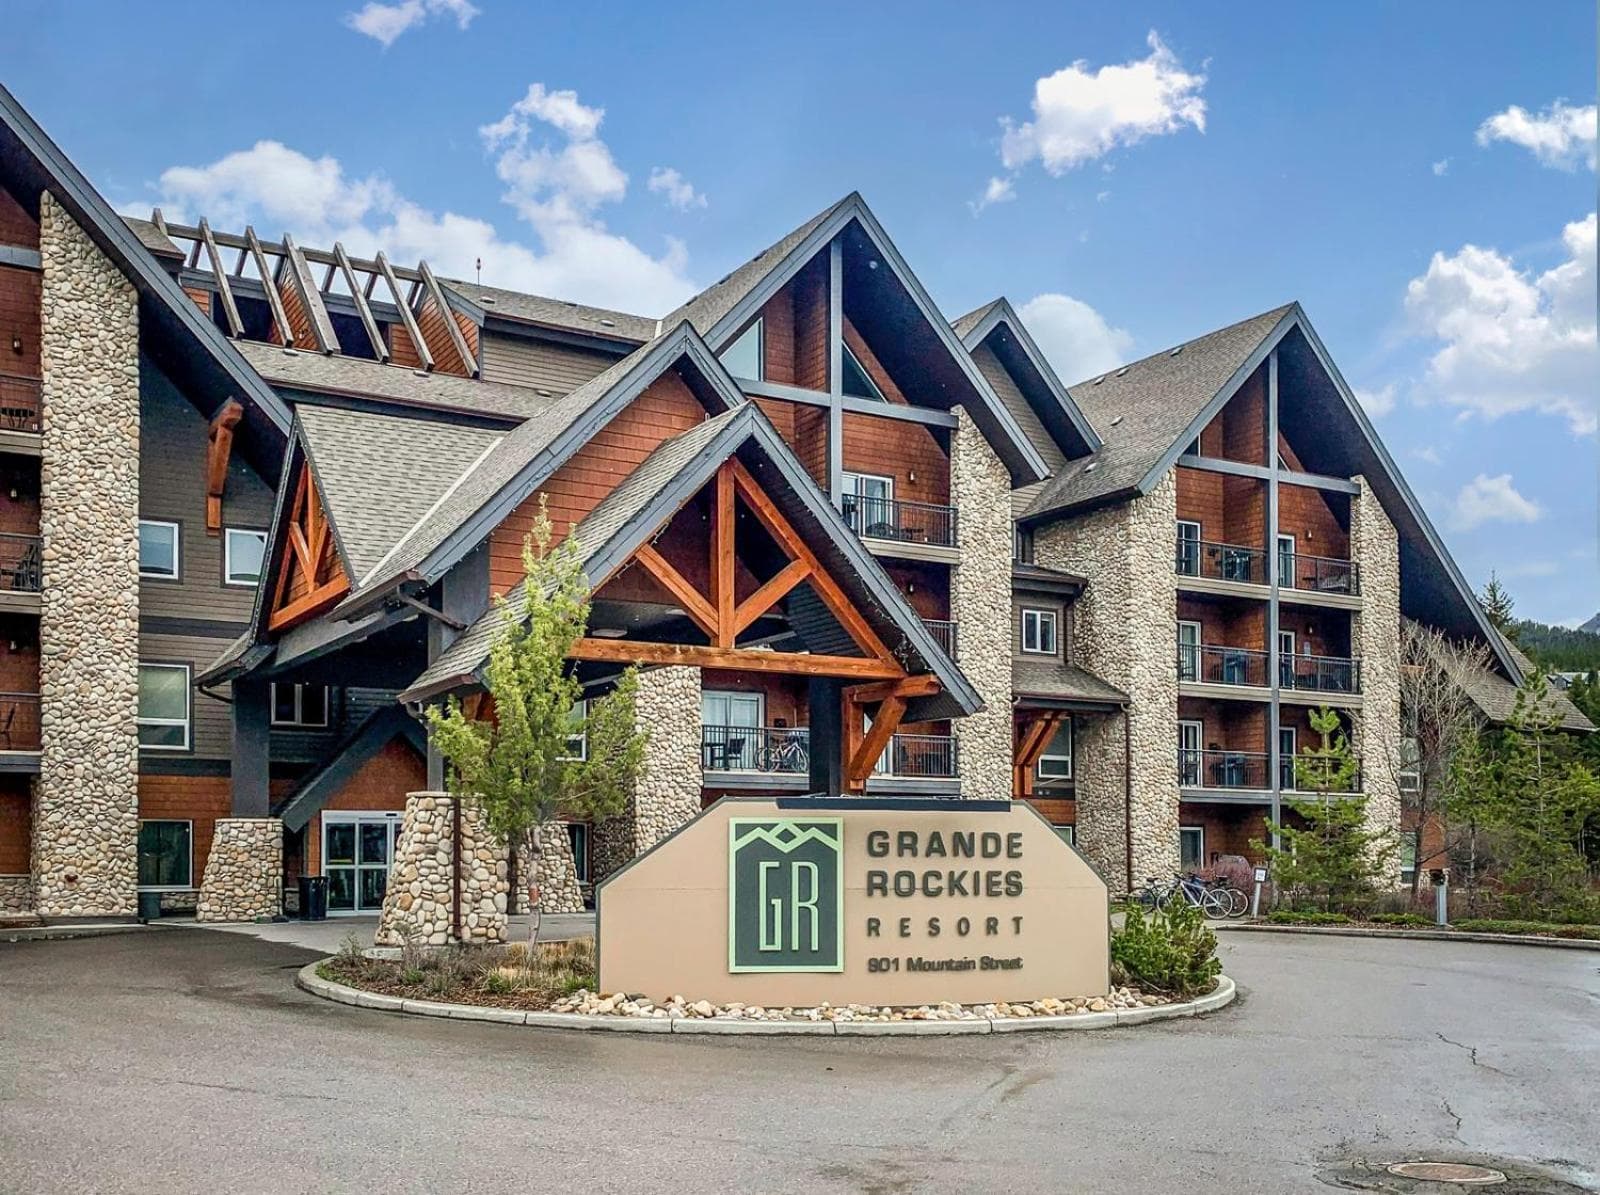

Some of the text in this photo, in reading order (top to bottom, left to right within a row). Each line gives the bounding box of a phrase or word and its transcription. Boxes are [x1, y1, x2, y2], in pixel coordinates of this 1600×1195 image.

[867, 830, 1023, 859] GRANDE
[866, 870, 1023, 898] ROCKIES
[759, 861, 819, 951] GR
[866, 916, 1024, 938] RESORT
[867, 955, 1024, 974] 901 Mountain Street
